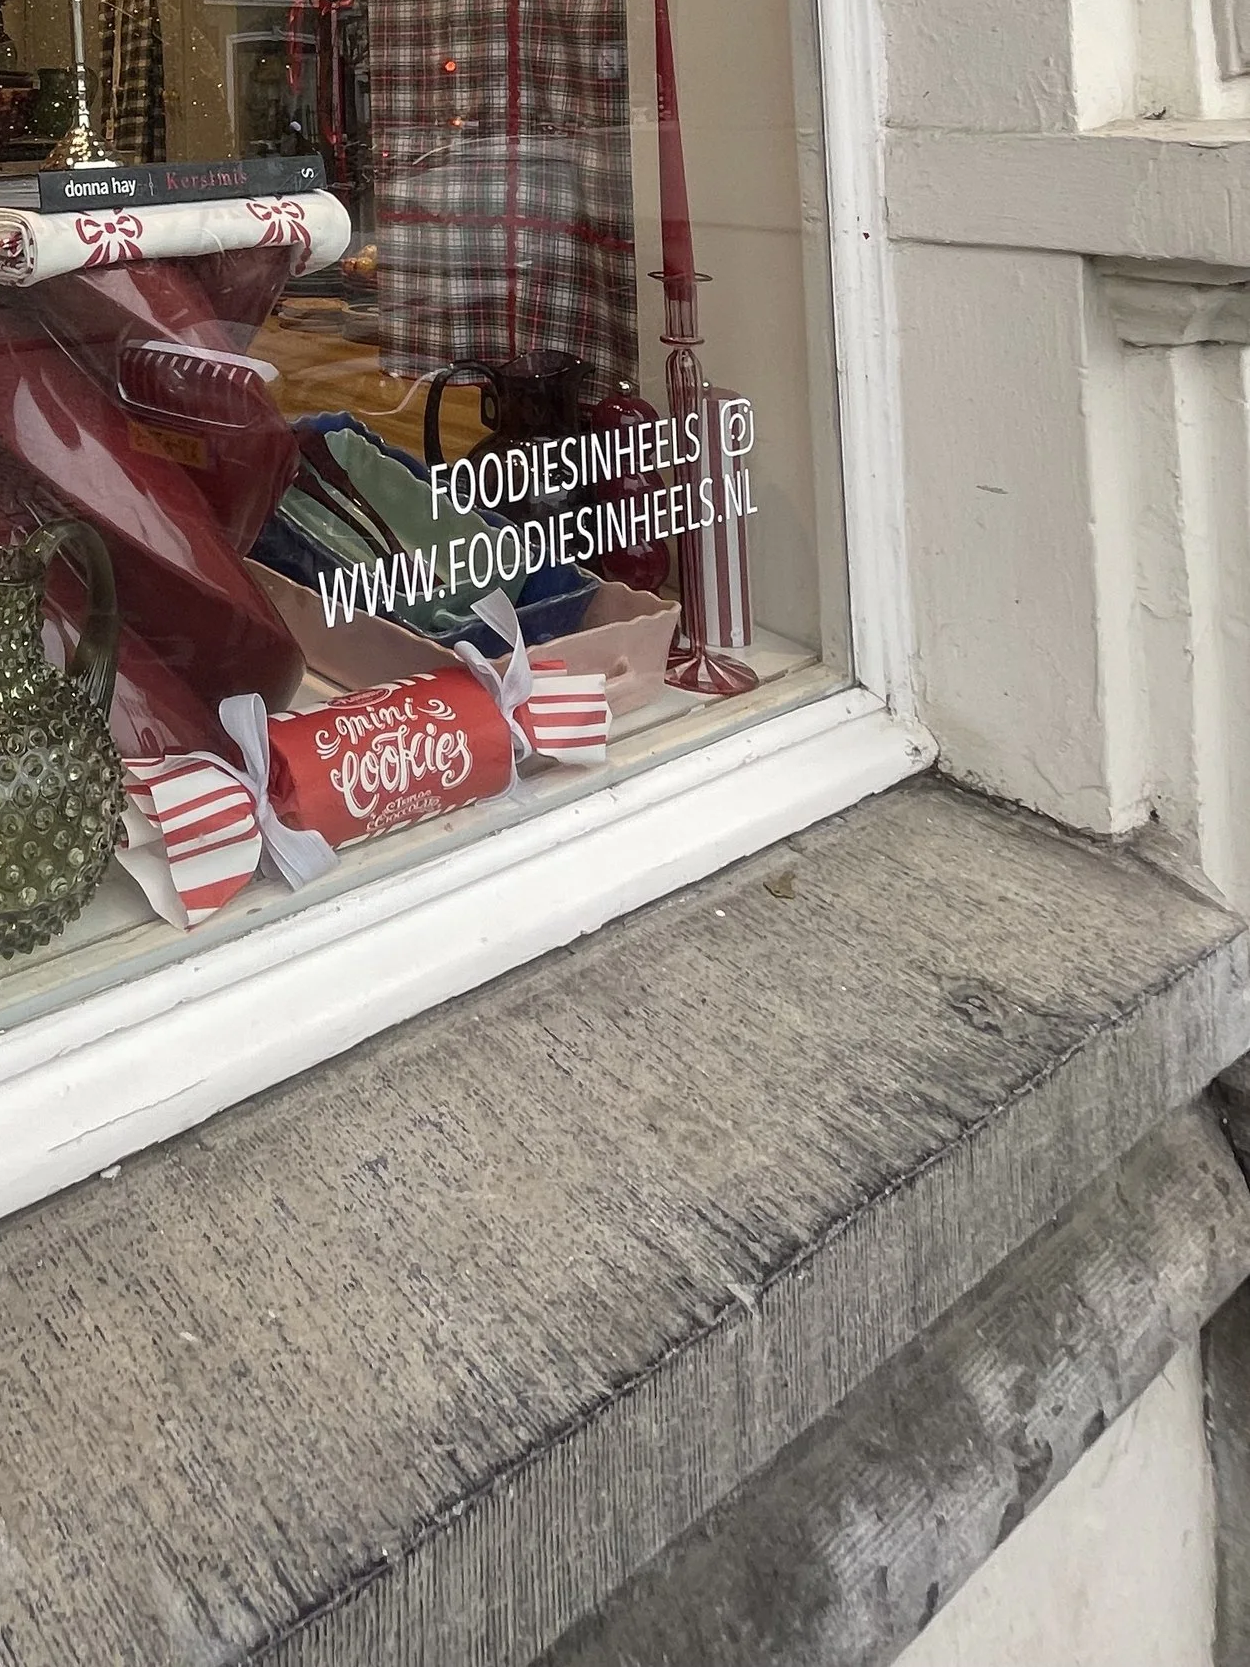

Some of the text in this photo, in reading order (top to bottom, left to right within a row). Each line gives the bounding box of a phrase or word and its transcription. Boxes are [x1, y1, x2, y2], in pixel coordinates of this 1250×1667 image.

[64, 177, 112, 198] donna
[111, 176, 137, 196] hay
[429, 412, 701, 521] FOODIESINHEELS
[317, 467, 759, 629] WWW.FOODIESINHEELS.NL
[335, 697, 418, 745] mini
[330, 722, 473, 819] Cookies
